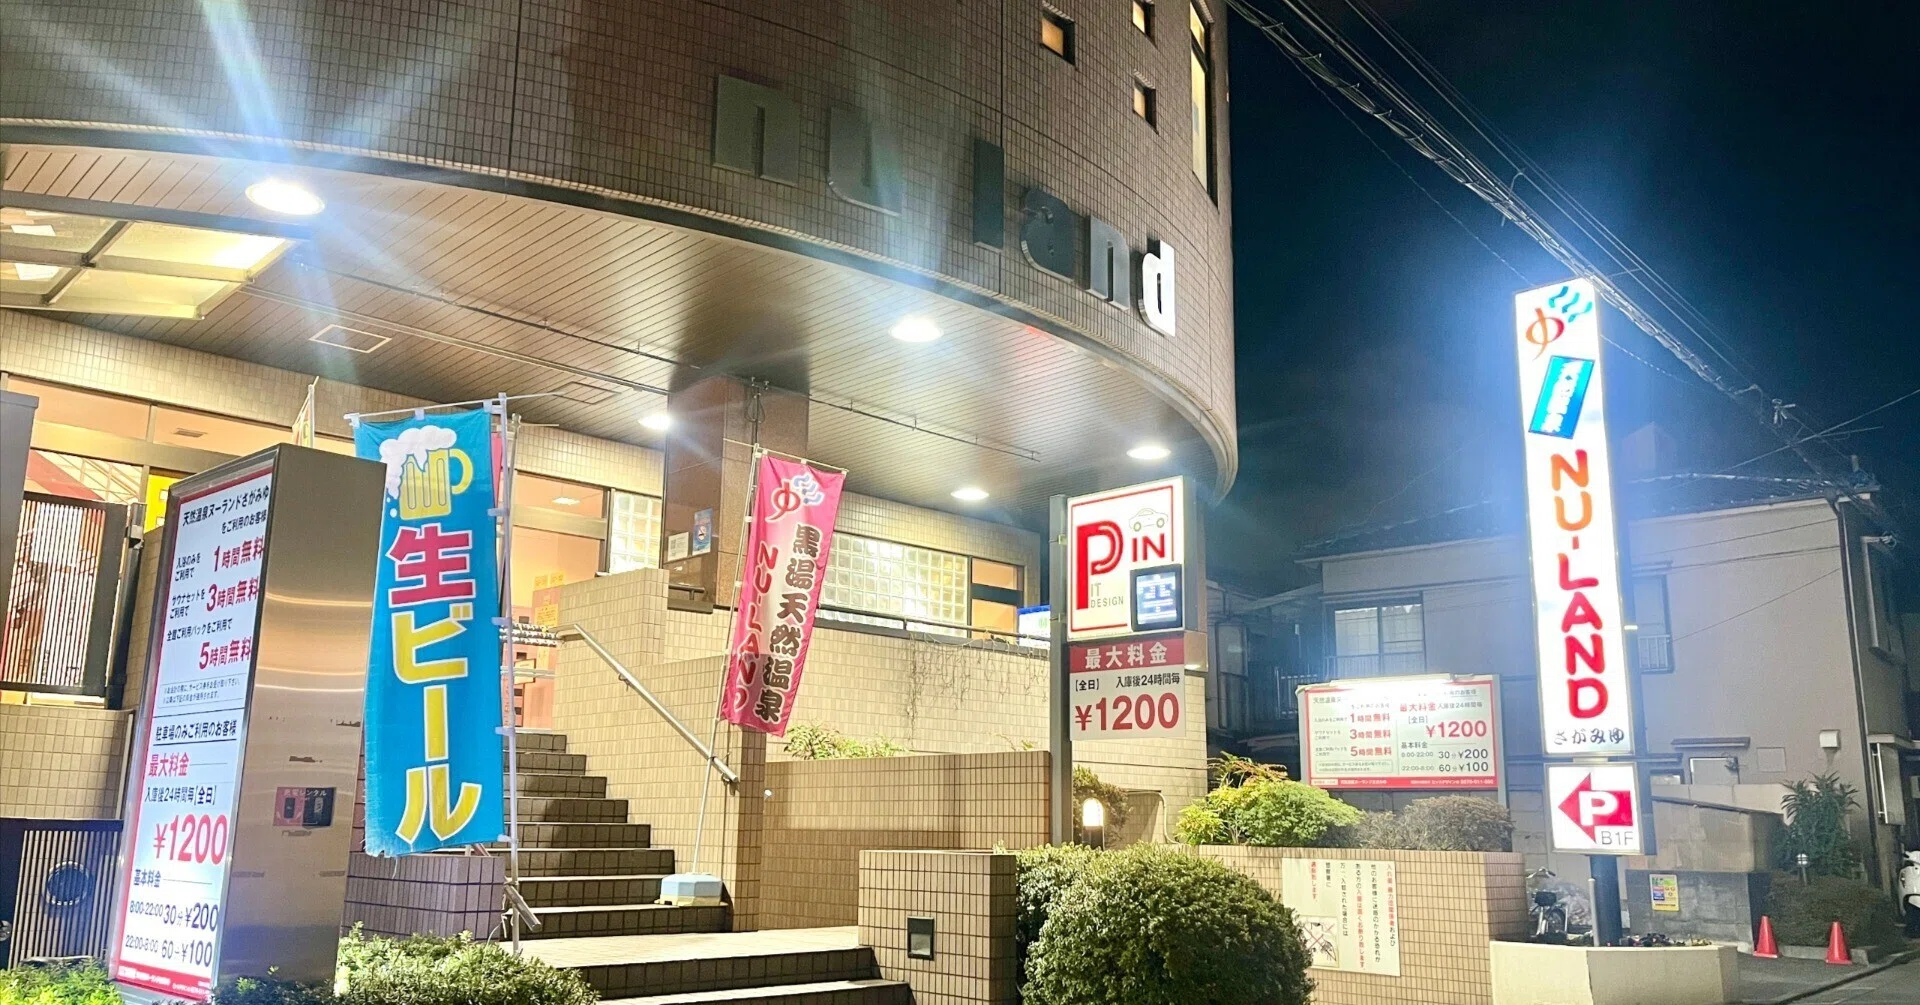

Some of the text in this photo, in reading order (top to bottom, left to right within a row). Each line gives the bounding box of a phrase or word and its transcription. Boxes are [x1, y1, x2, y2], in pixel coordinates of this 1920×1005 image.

[182, 484, 270, 527] 天然温泉ヌーランドさがみゆ
[221, 509, 268, 535] をご利用のお客様
[214, 535, 265, 573] 1時間無料
[206, 576, 260, 612] 3時間無料
[1551, 449, 1608, 719] NU-LAND
[1090, 596, 1124, 609] DESIGN
[733, 542, 778, 711] NU-LAND
[754, 523, 822, 722] 黒湯天然温泉
[199, 635, 252, 670] 5時間無料
[1085, 642, 1168, 670] 最大料金
[385, 523, 482, 845] 生ビール
[1115, 672, 1181, 689] 入庫後24時間毎
[1074, 692, 1180, 731] ¥1200
[155, 719, 237, 741] 駐車場のみご利用のお客様
[1349, 728, 1392, 740] 3時間無料
[1425, 720, 1487, 738] ¥1200
[1554, 727, 1625, 745] さがみゆ
[1350, 745, 1393, 757] 5時間無料
[1458, 748, 1489, 759] ¥200
[148, 752, 190, 777] 最大料金
[1459, 761, 1489, 772] ¥100
[1578, 790, 1618, 827] P
[153, 813, 228, 865] ¥1200
[1601, 831, 1633, 845] B1F
[133, 868, 162, 888] 基本料金
